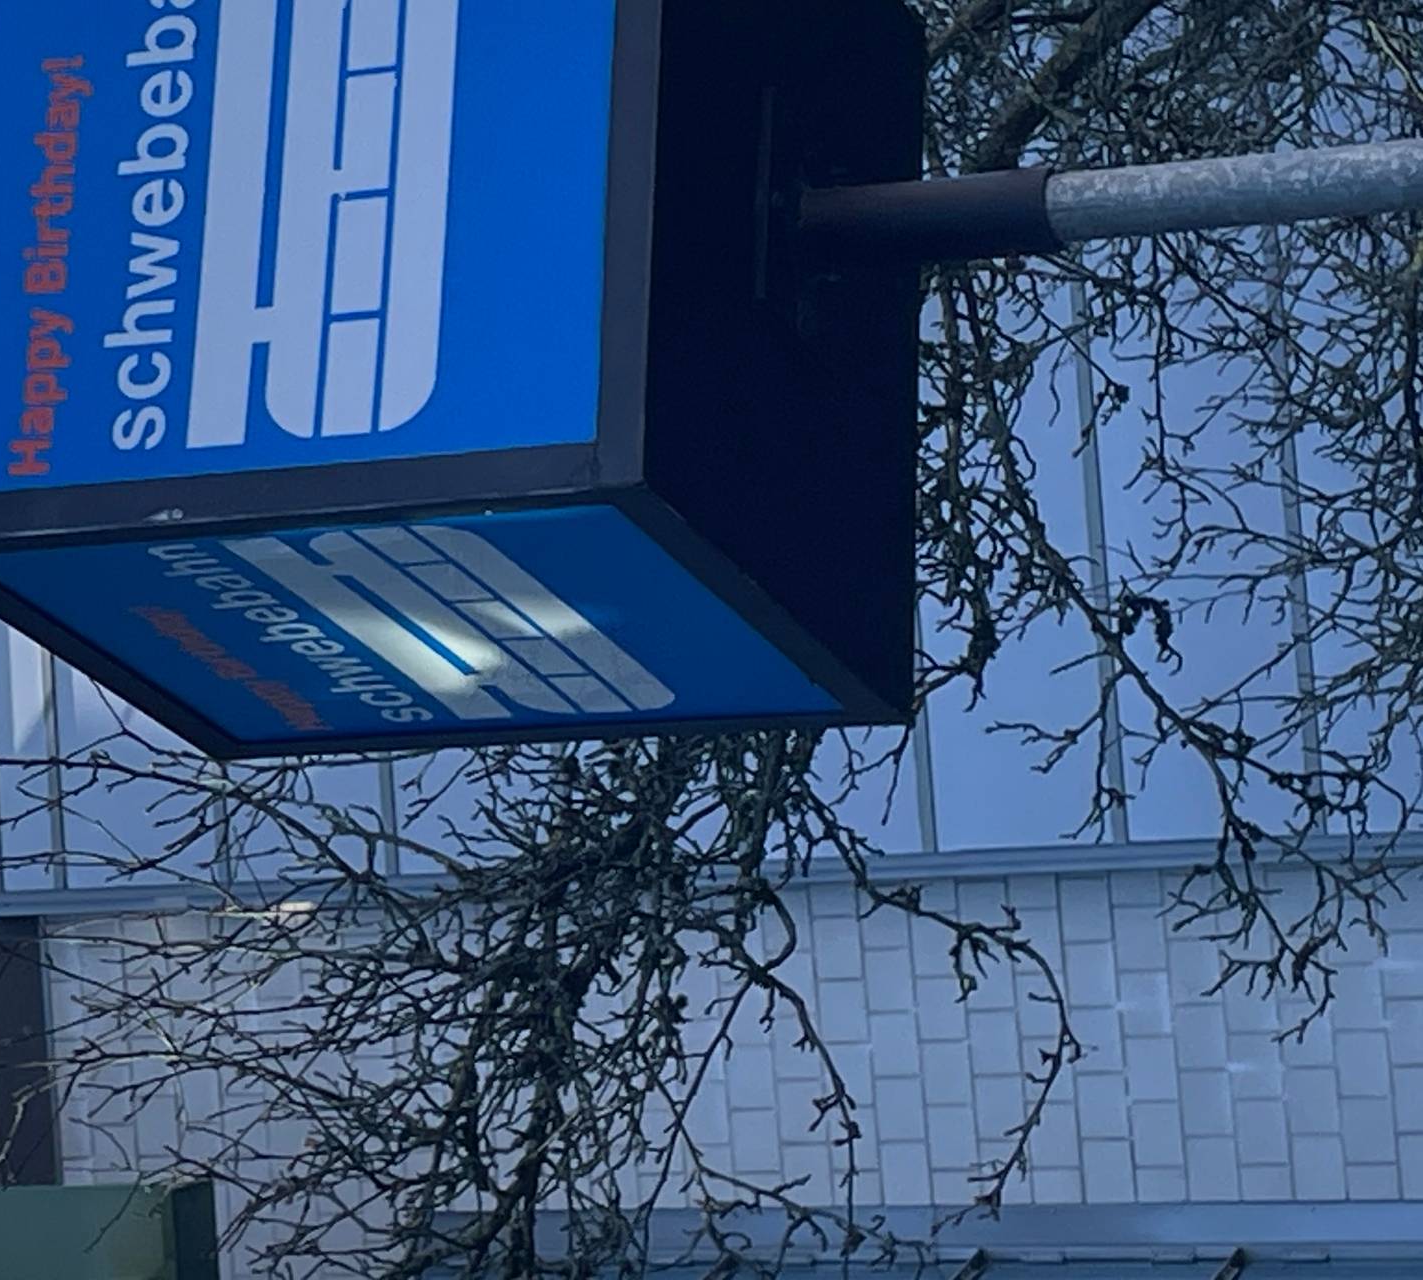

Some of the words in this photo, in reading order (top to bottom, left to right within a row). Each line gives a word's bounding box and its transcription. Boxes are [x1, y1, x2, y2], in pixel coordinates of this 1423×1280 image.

[23, 55, 93, 295] Birthday!
[8, 309, 74, 477] Happy
[148, 543, 434, 723] schwebebahn
